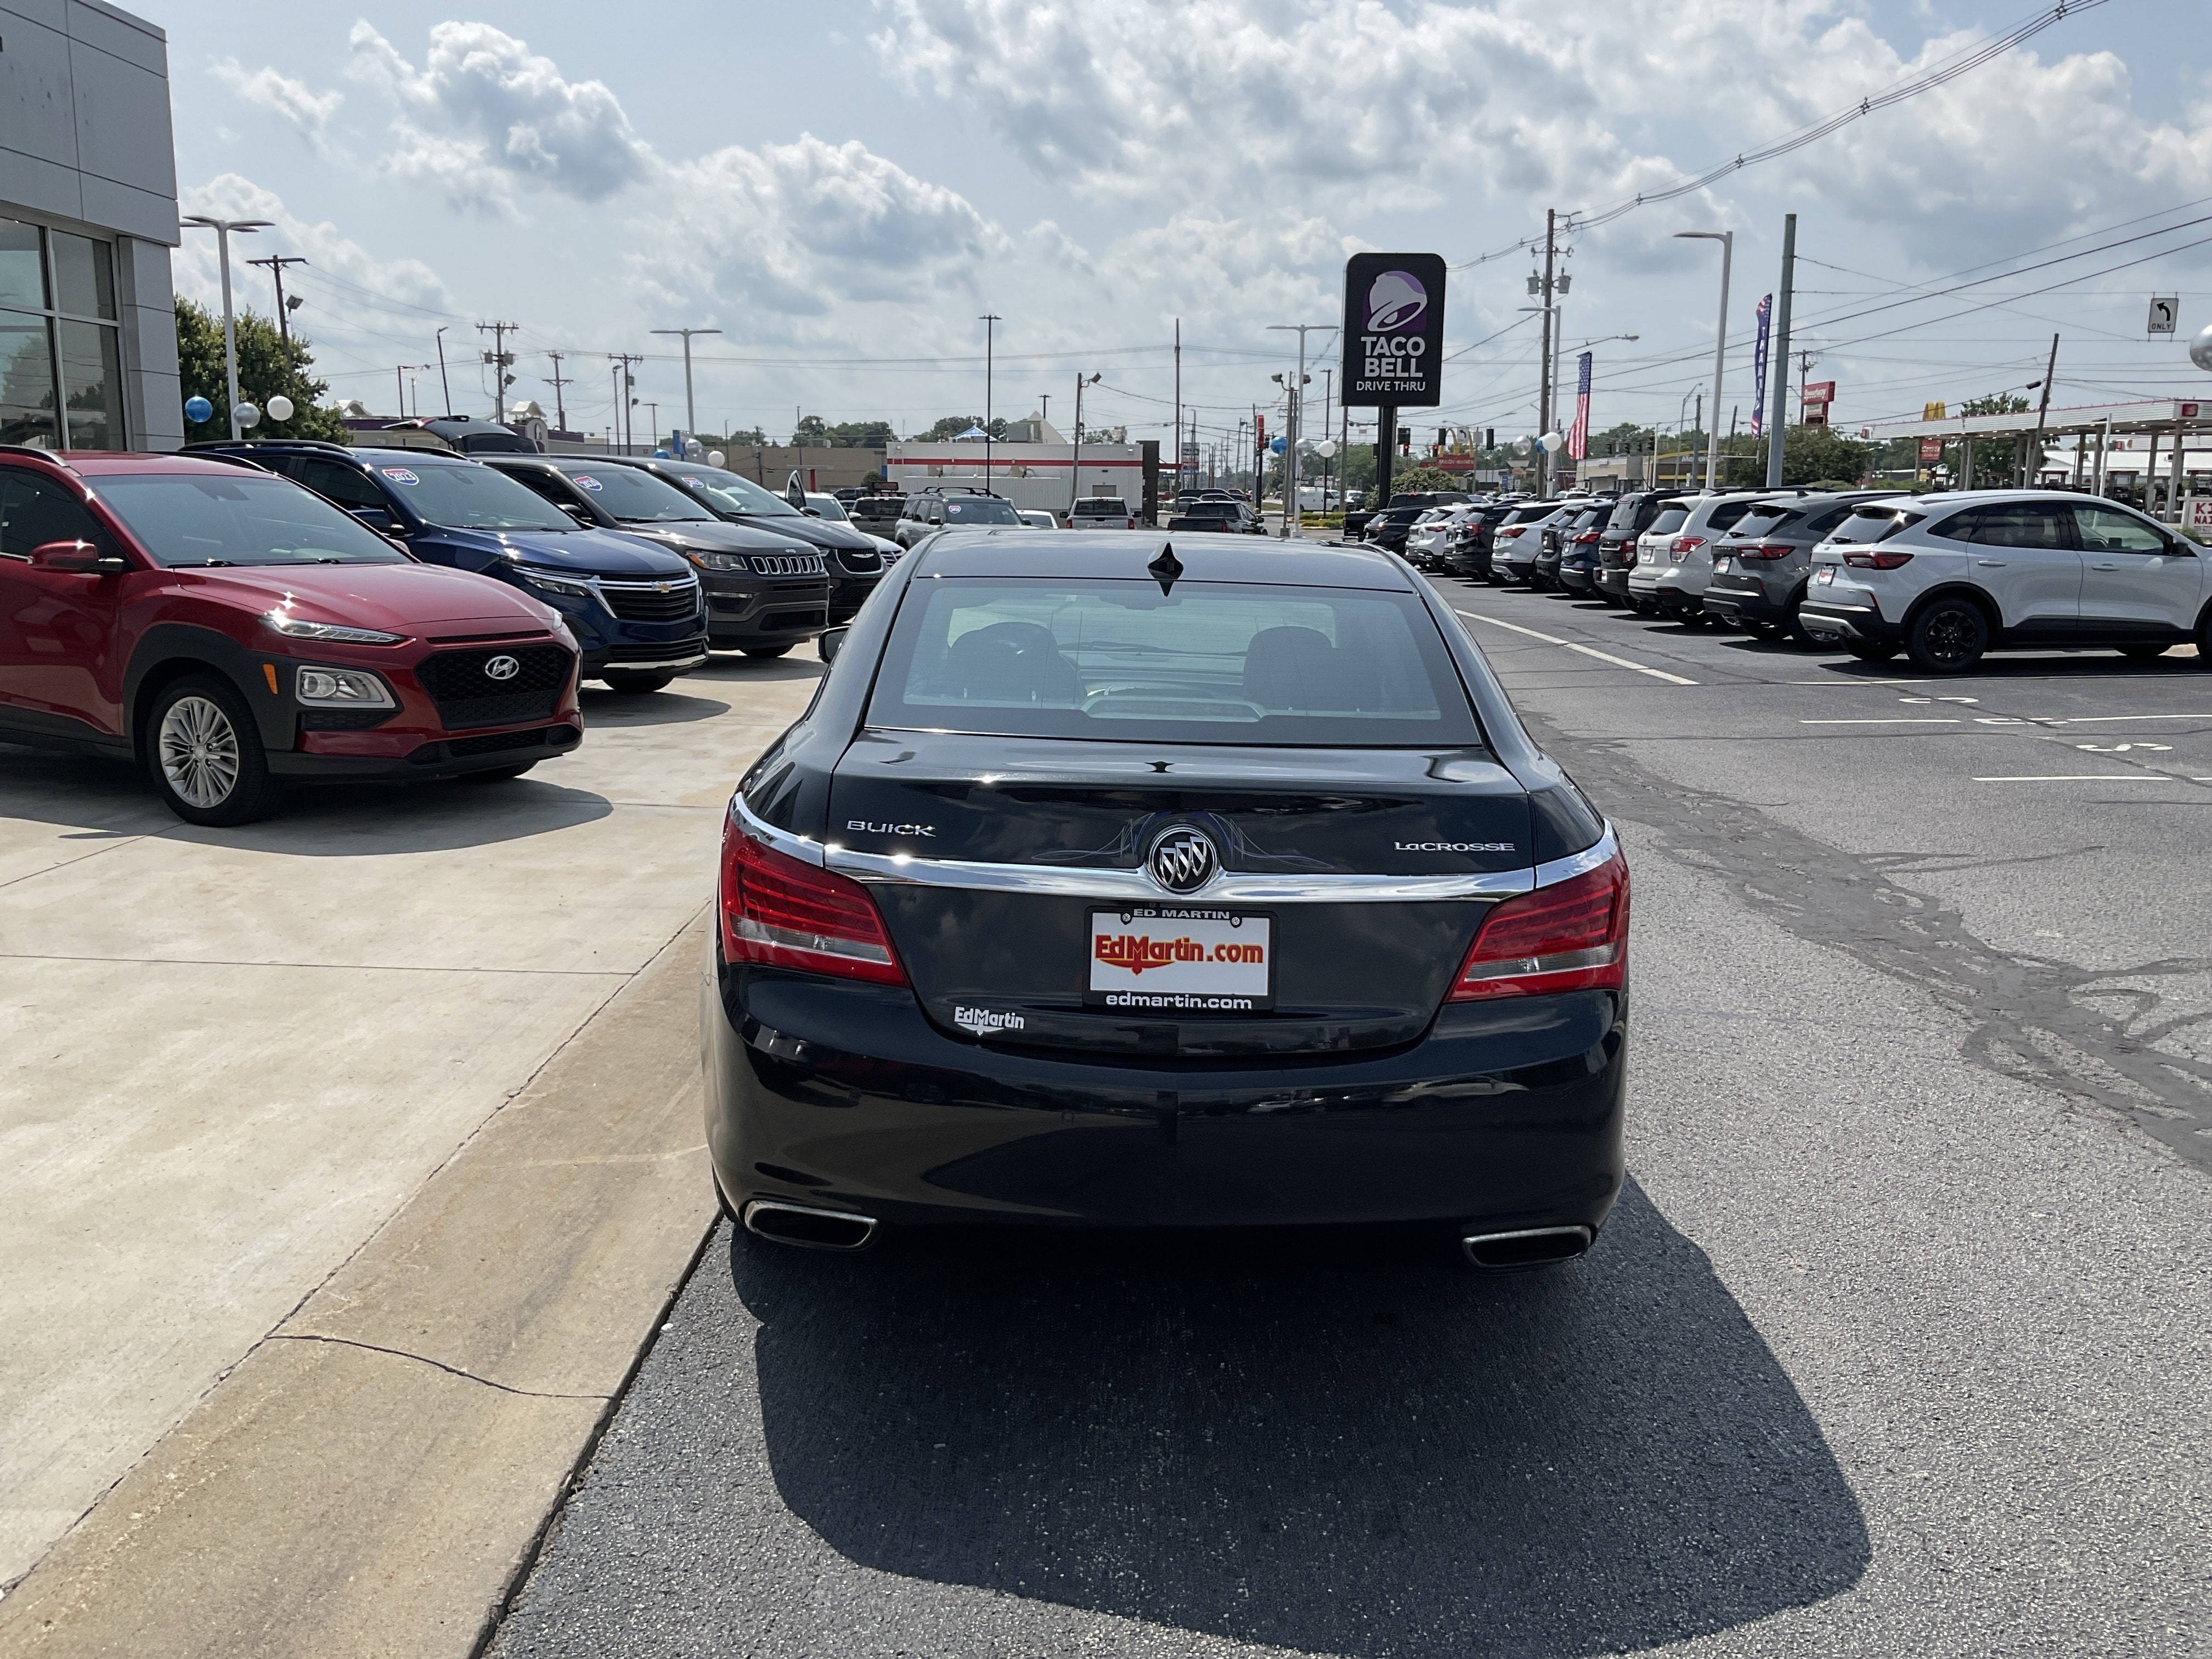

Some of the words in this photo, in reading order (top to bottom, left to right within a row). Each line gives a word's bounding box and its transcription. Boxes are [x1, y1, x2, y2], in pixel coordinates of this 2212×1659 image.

[1361, 336, 1426, 357] TACO
[1364, 358, 1423, 377] BELL
[1356, 381, 1391, 391] DRIVE
[1393, 381, 1426, 391] THRU
[389, 473, 416, 481] 2023
[847, 820, 936, 837] BUICK
[1133, 909, 1156, 917] ED
[1162, 910, 1230, 919] MARTIN
[1095, 934, 1263, 964] EdMartin.com
[1106, 992, 1252, 1009] edmartin.com
[955, 1006, 1024, 1030] EdMartin
